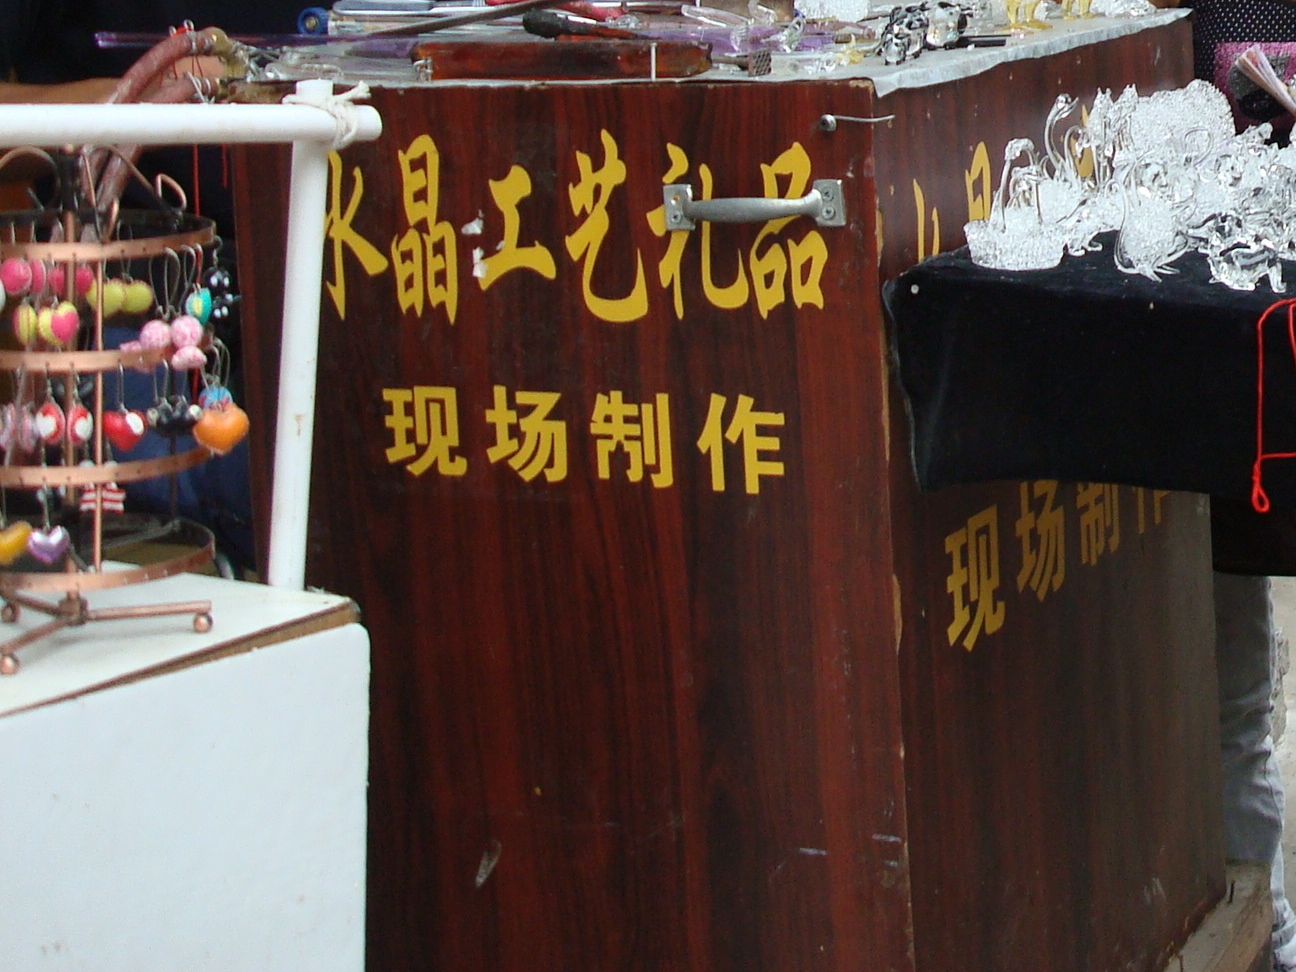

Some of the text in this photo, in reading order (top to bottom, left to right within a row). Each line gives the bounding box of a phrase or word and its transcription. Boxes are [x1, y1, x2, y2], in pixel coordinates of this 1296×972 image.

[326, 129, 829, 325] 水晶工艺礼品
[382, 384, 786, 495] 现场制作
